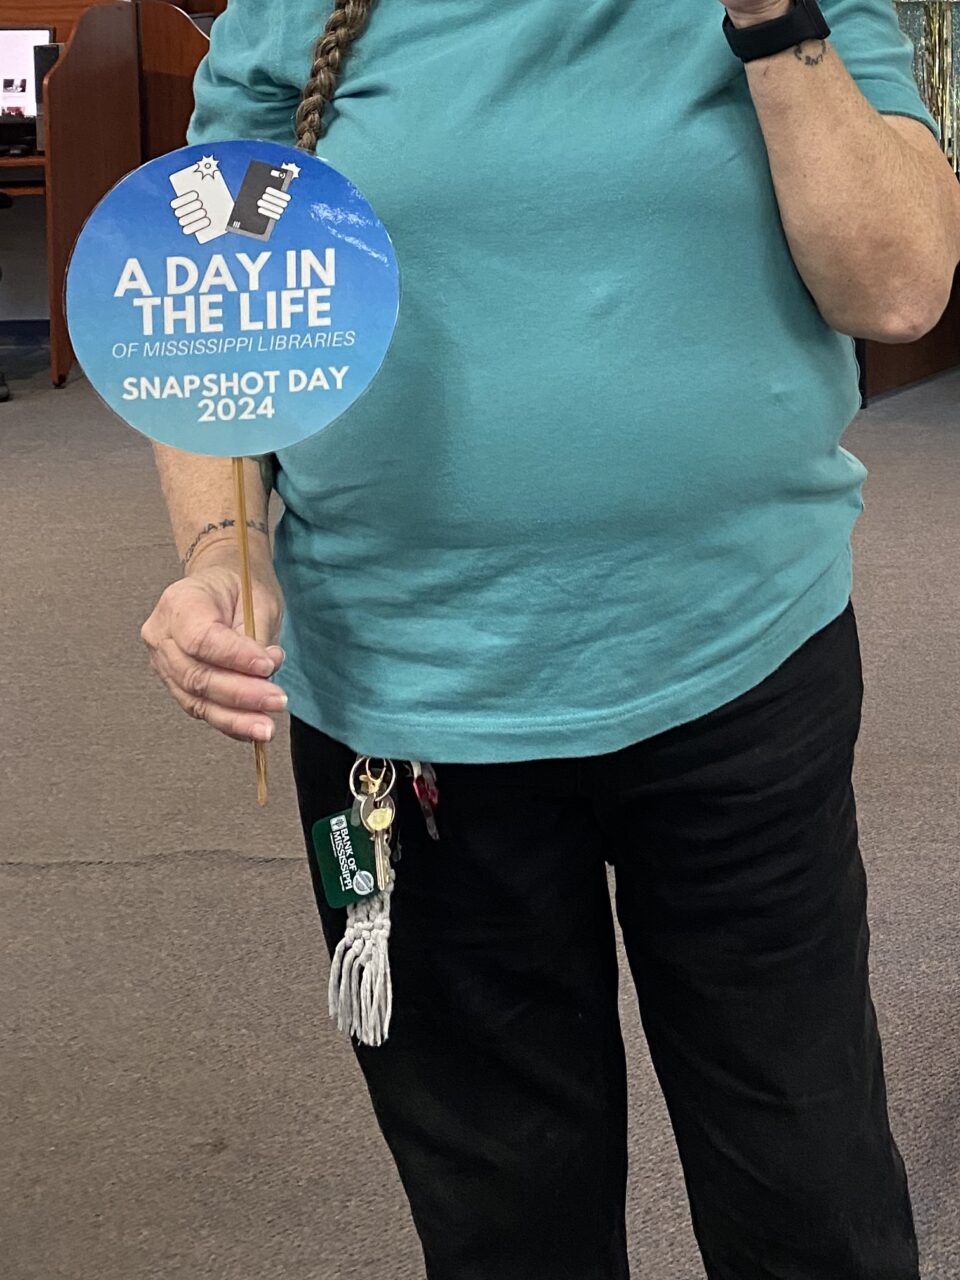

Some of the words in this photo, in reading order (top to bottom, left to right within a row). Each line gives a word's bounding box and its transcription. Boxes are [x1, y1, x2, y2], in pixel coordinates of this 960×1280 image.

[114, 258, 153, 297] A
[167, 251, 272, 295] DAY
[286, 247, 336, 288] IN
[133, 295, 224, 336] THE
[240, 288, 331, 331] LIFE
[112, 341, 140, 358] OF
[143, 336, 254, 357] MISSISSIPPI
[257, 330, 355, 352] LIBRARIES
[122, 371, 280, 400] SNAPSHOT
[288, 366, 350, 392] DAY
[198, 396, 275, 422] 2024
[332, 831, 353, 891] MISSISSIPPI
[340, 827, 354, 857] BANK
[347, 857, 357, 871] OF
